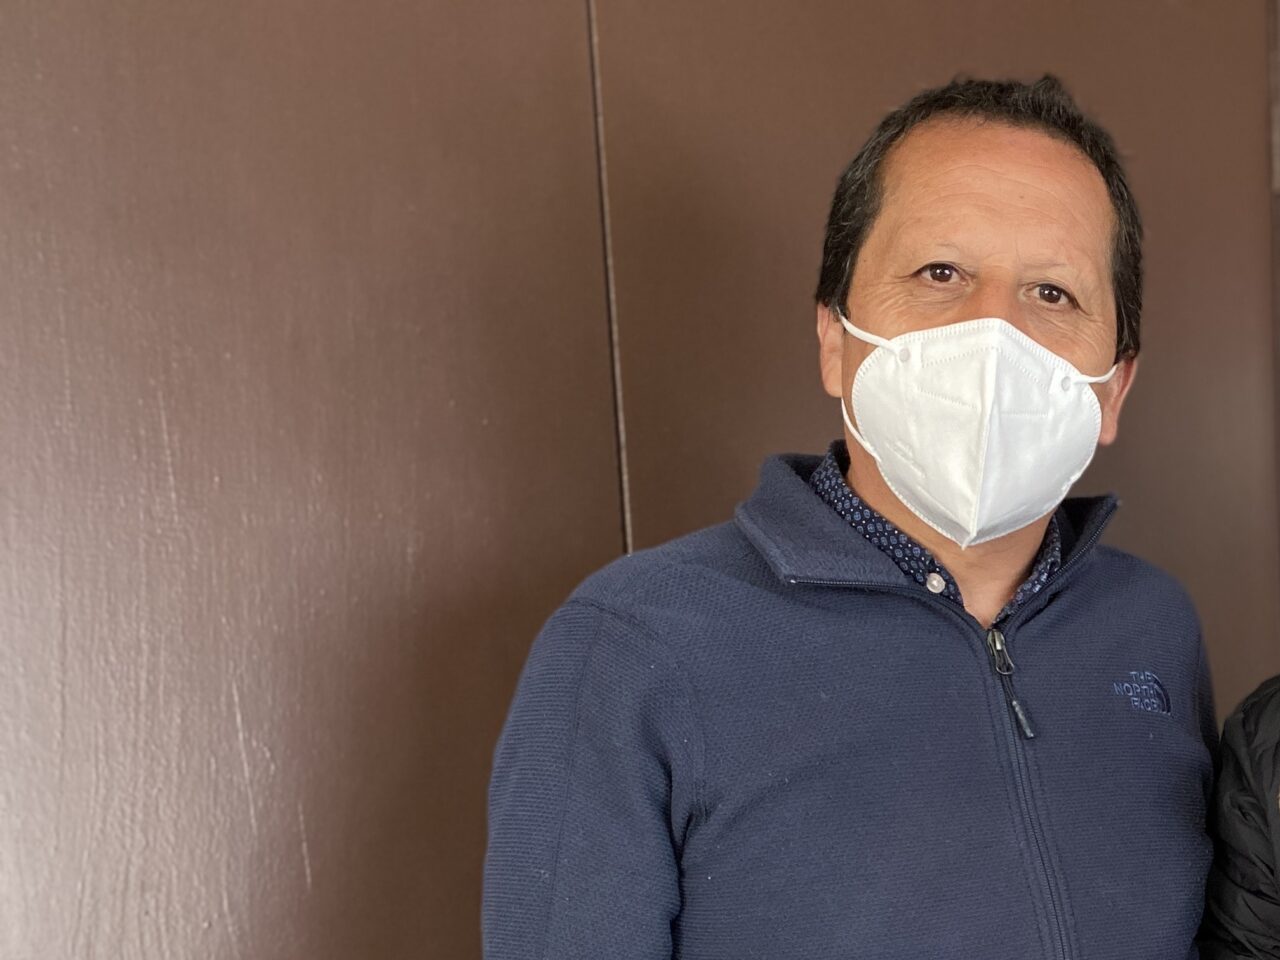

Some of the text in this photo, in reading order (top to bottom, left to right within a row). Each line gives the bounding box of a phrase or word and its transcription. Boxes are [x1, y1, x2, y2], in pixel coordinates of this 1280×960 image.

[1129, 671, 1153, 681] THE
[1113, 682, 1159, 697] NORTH
[1131, 697, 1159, 712] FACE
